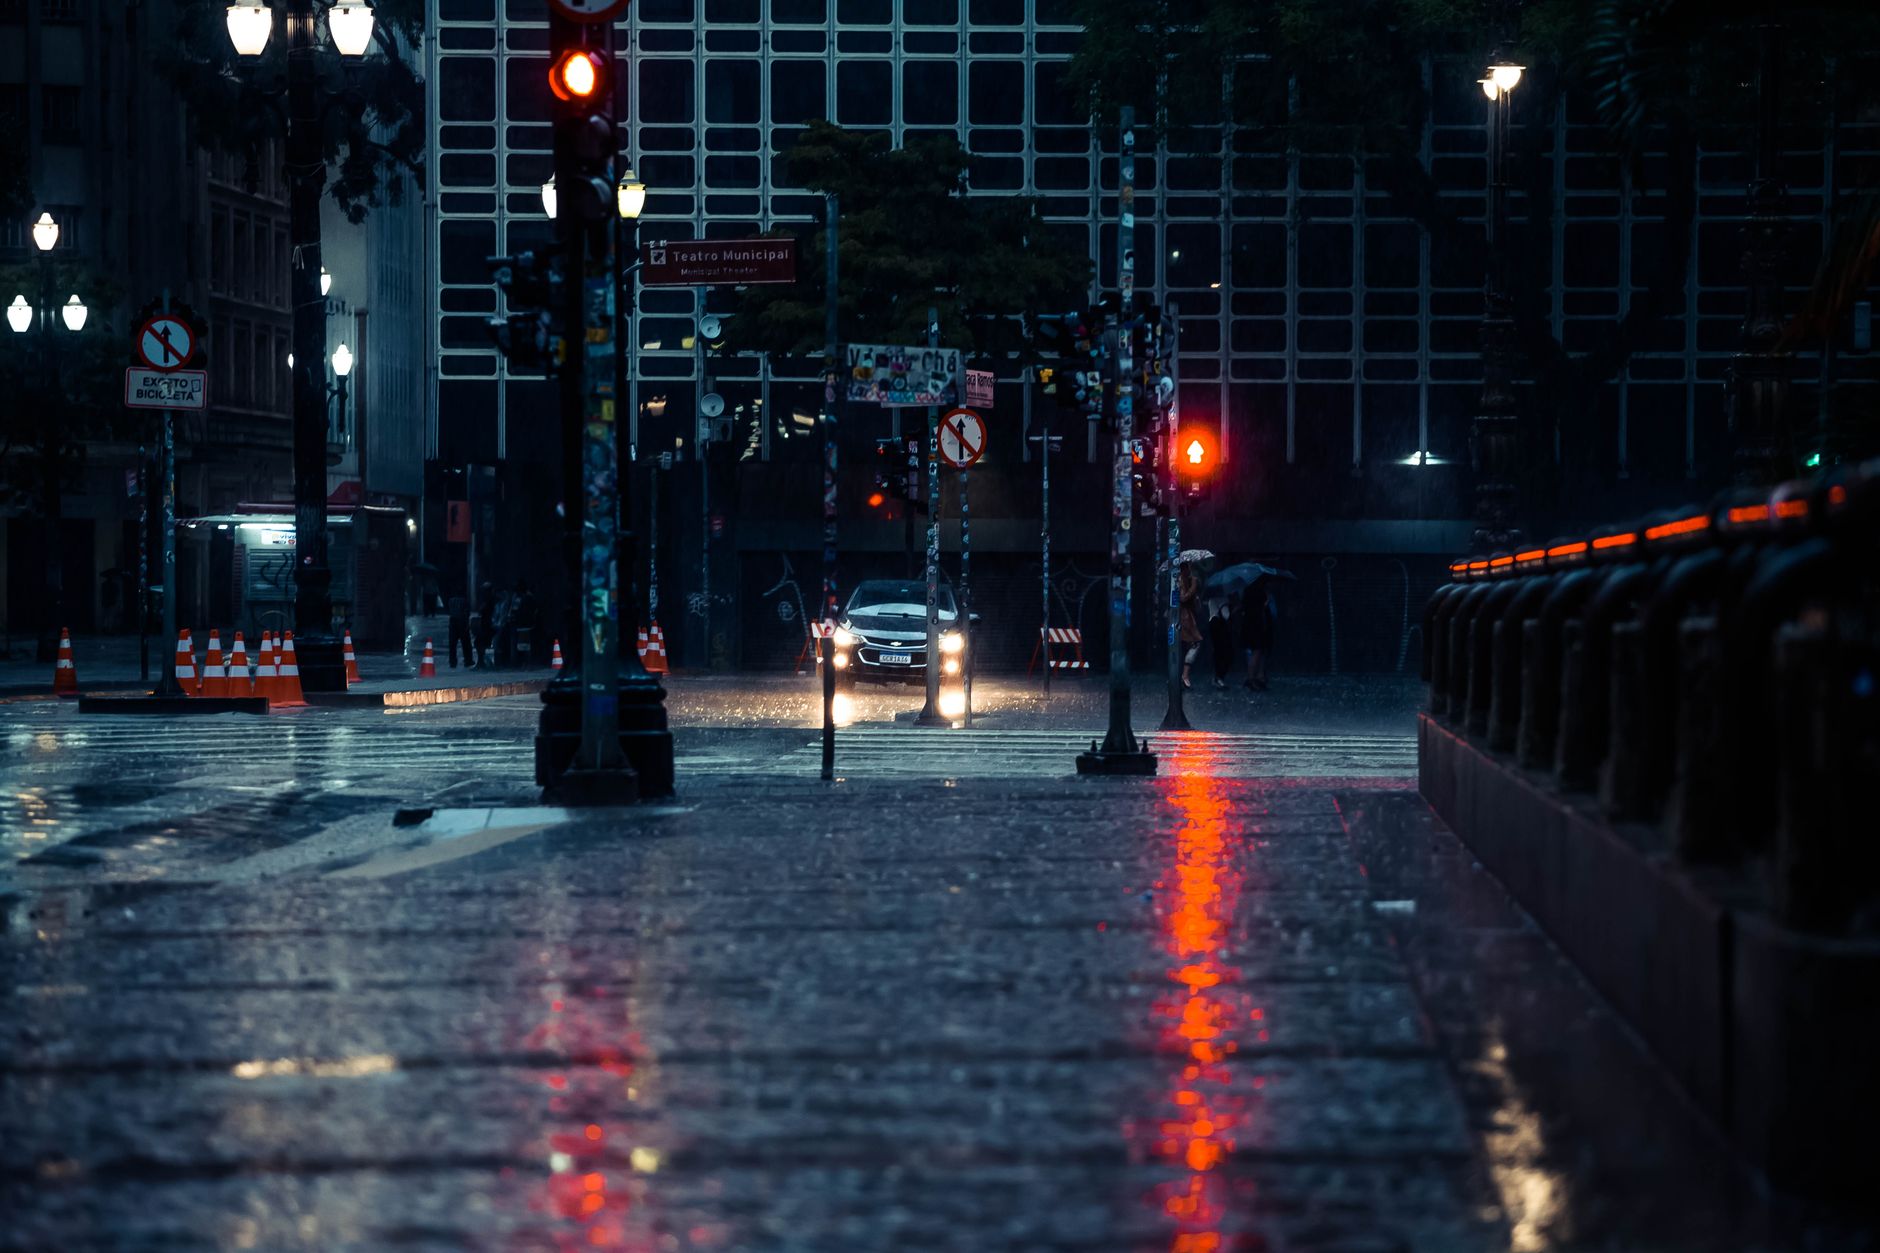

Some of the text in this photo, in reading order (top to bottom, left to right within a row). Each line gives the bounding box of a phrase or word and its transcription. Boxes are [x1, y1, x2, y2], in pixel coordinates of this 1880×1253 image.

[673, 249, 789, 262] Teatro Municipal
[143, 377, 188, 388] EXCTO
